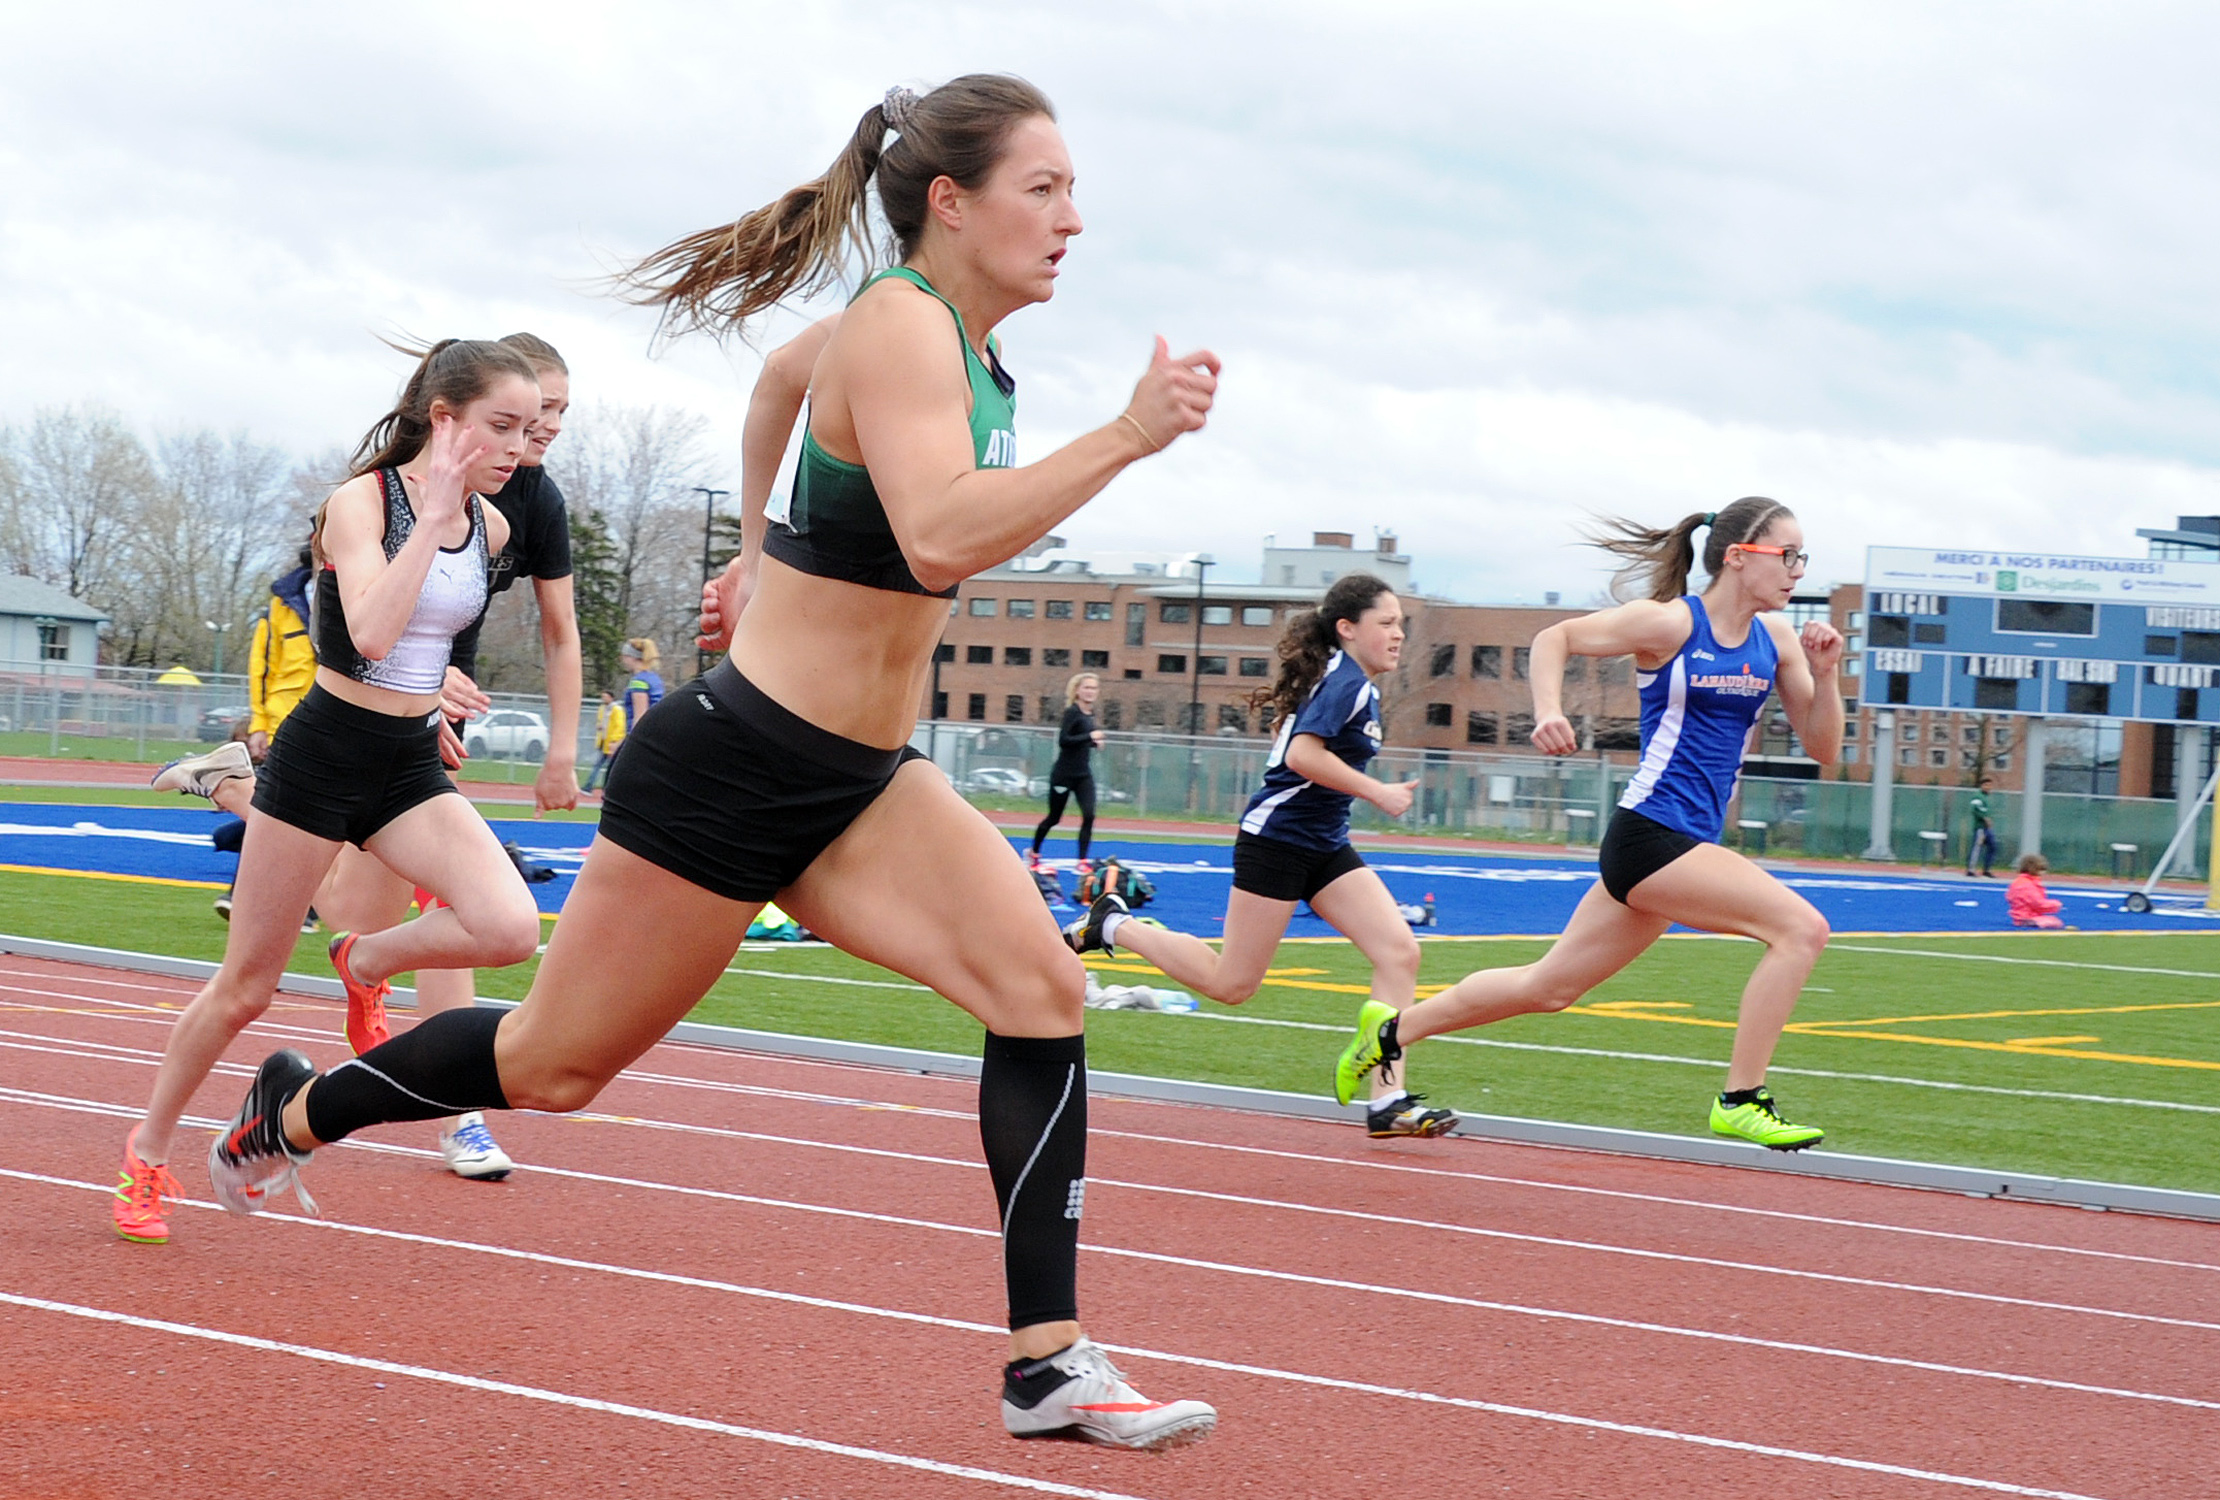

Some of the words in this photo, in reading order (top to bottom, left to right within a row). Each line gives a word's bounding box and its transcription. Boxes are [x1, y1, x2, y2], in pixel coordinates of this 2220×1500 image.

[1934, 552, 1984, 566] MERCI
[2006, 556, 2044, 569] NOS
[2021, 575, 2100, 592] Desjardins
[1880, 593, 1940, 615] LOCAL
[1985, 657, 2034, 679] FAIRE
[2153, 666, 2213, 688] QUART
